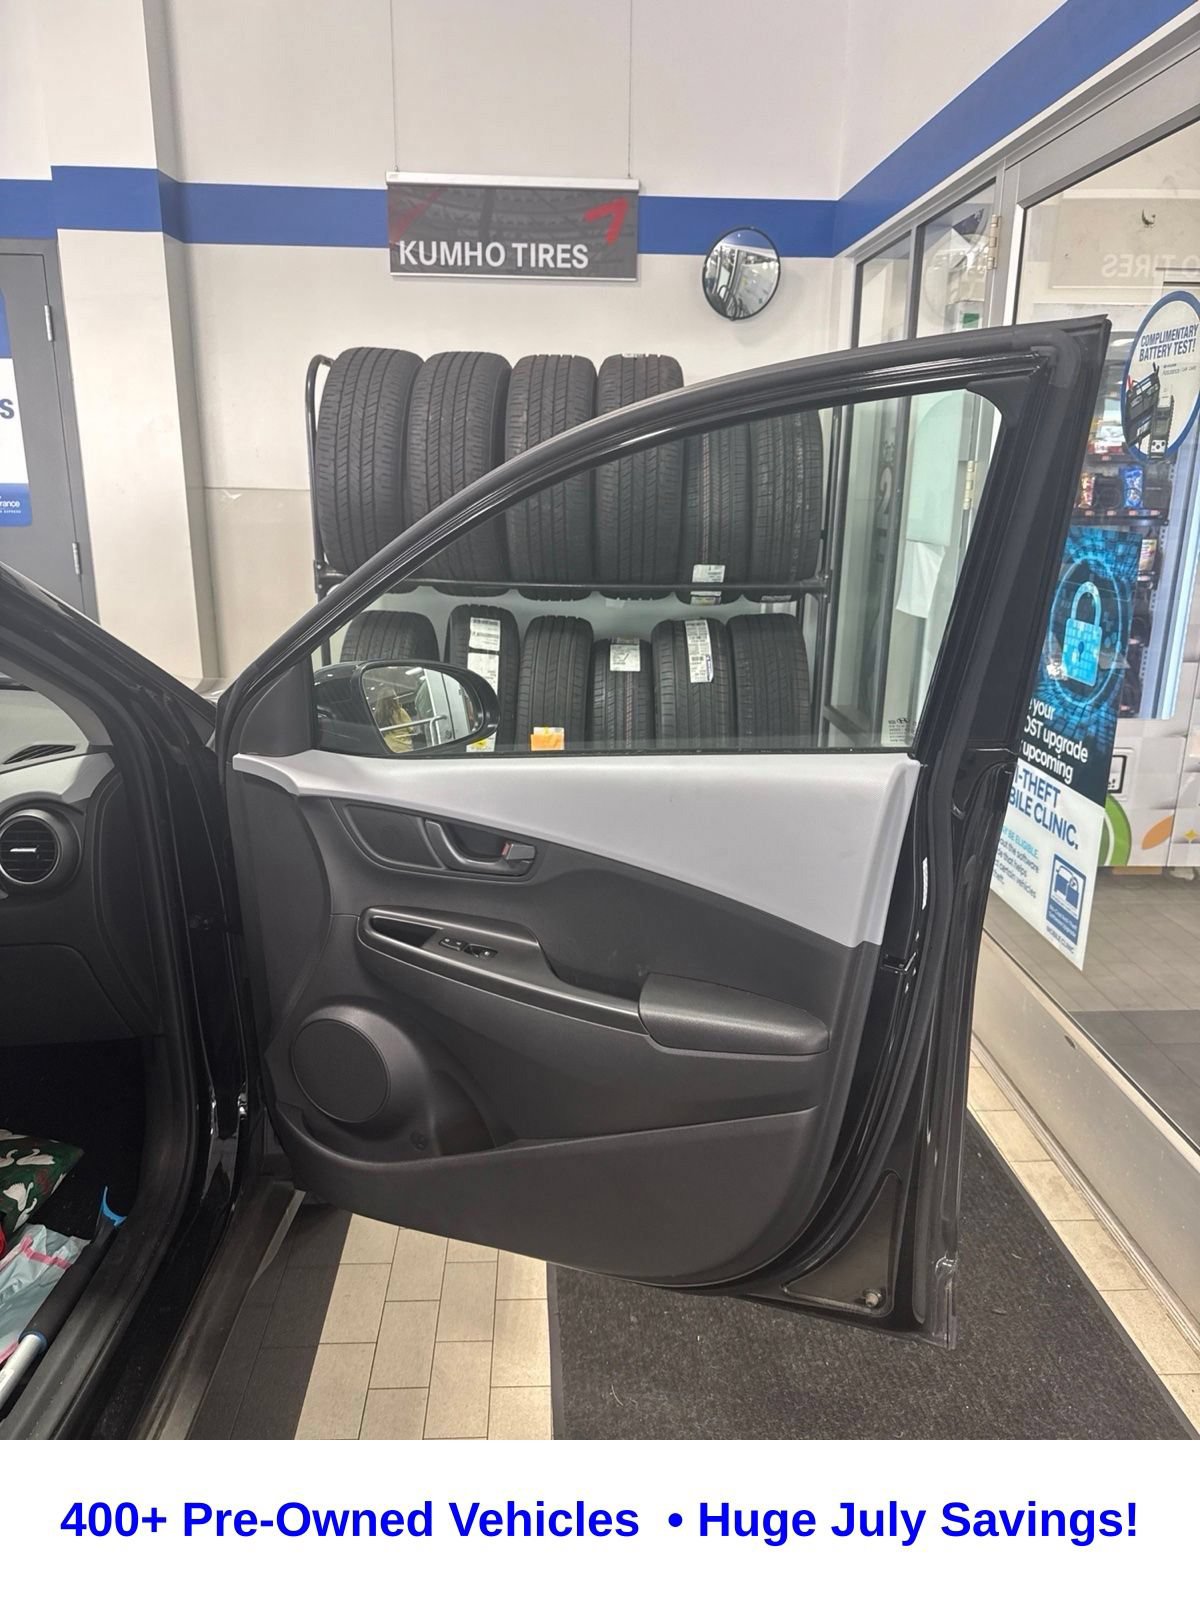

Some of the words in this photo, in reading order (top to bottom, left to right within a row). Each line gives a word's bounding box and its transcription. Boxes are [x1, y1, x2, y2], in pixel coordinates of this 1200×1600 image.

[398, 240, 505, 267] KUMHO
[511, 242, 589, 269] TIRES
[1140, 323, 1199, 347] COMPLIMENTARY
[1139, 343, 1173, 362] BATTERY
[1173, 338, 1197, 356] TEST!
[1032, 697, 1056, 721] your
[1043, 727, 1089, 763] upgrade
[1022, 741, 1074, 785] upcoming
[1034, 802, 1079, 850] CLINIC.
